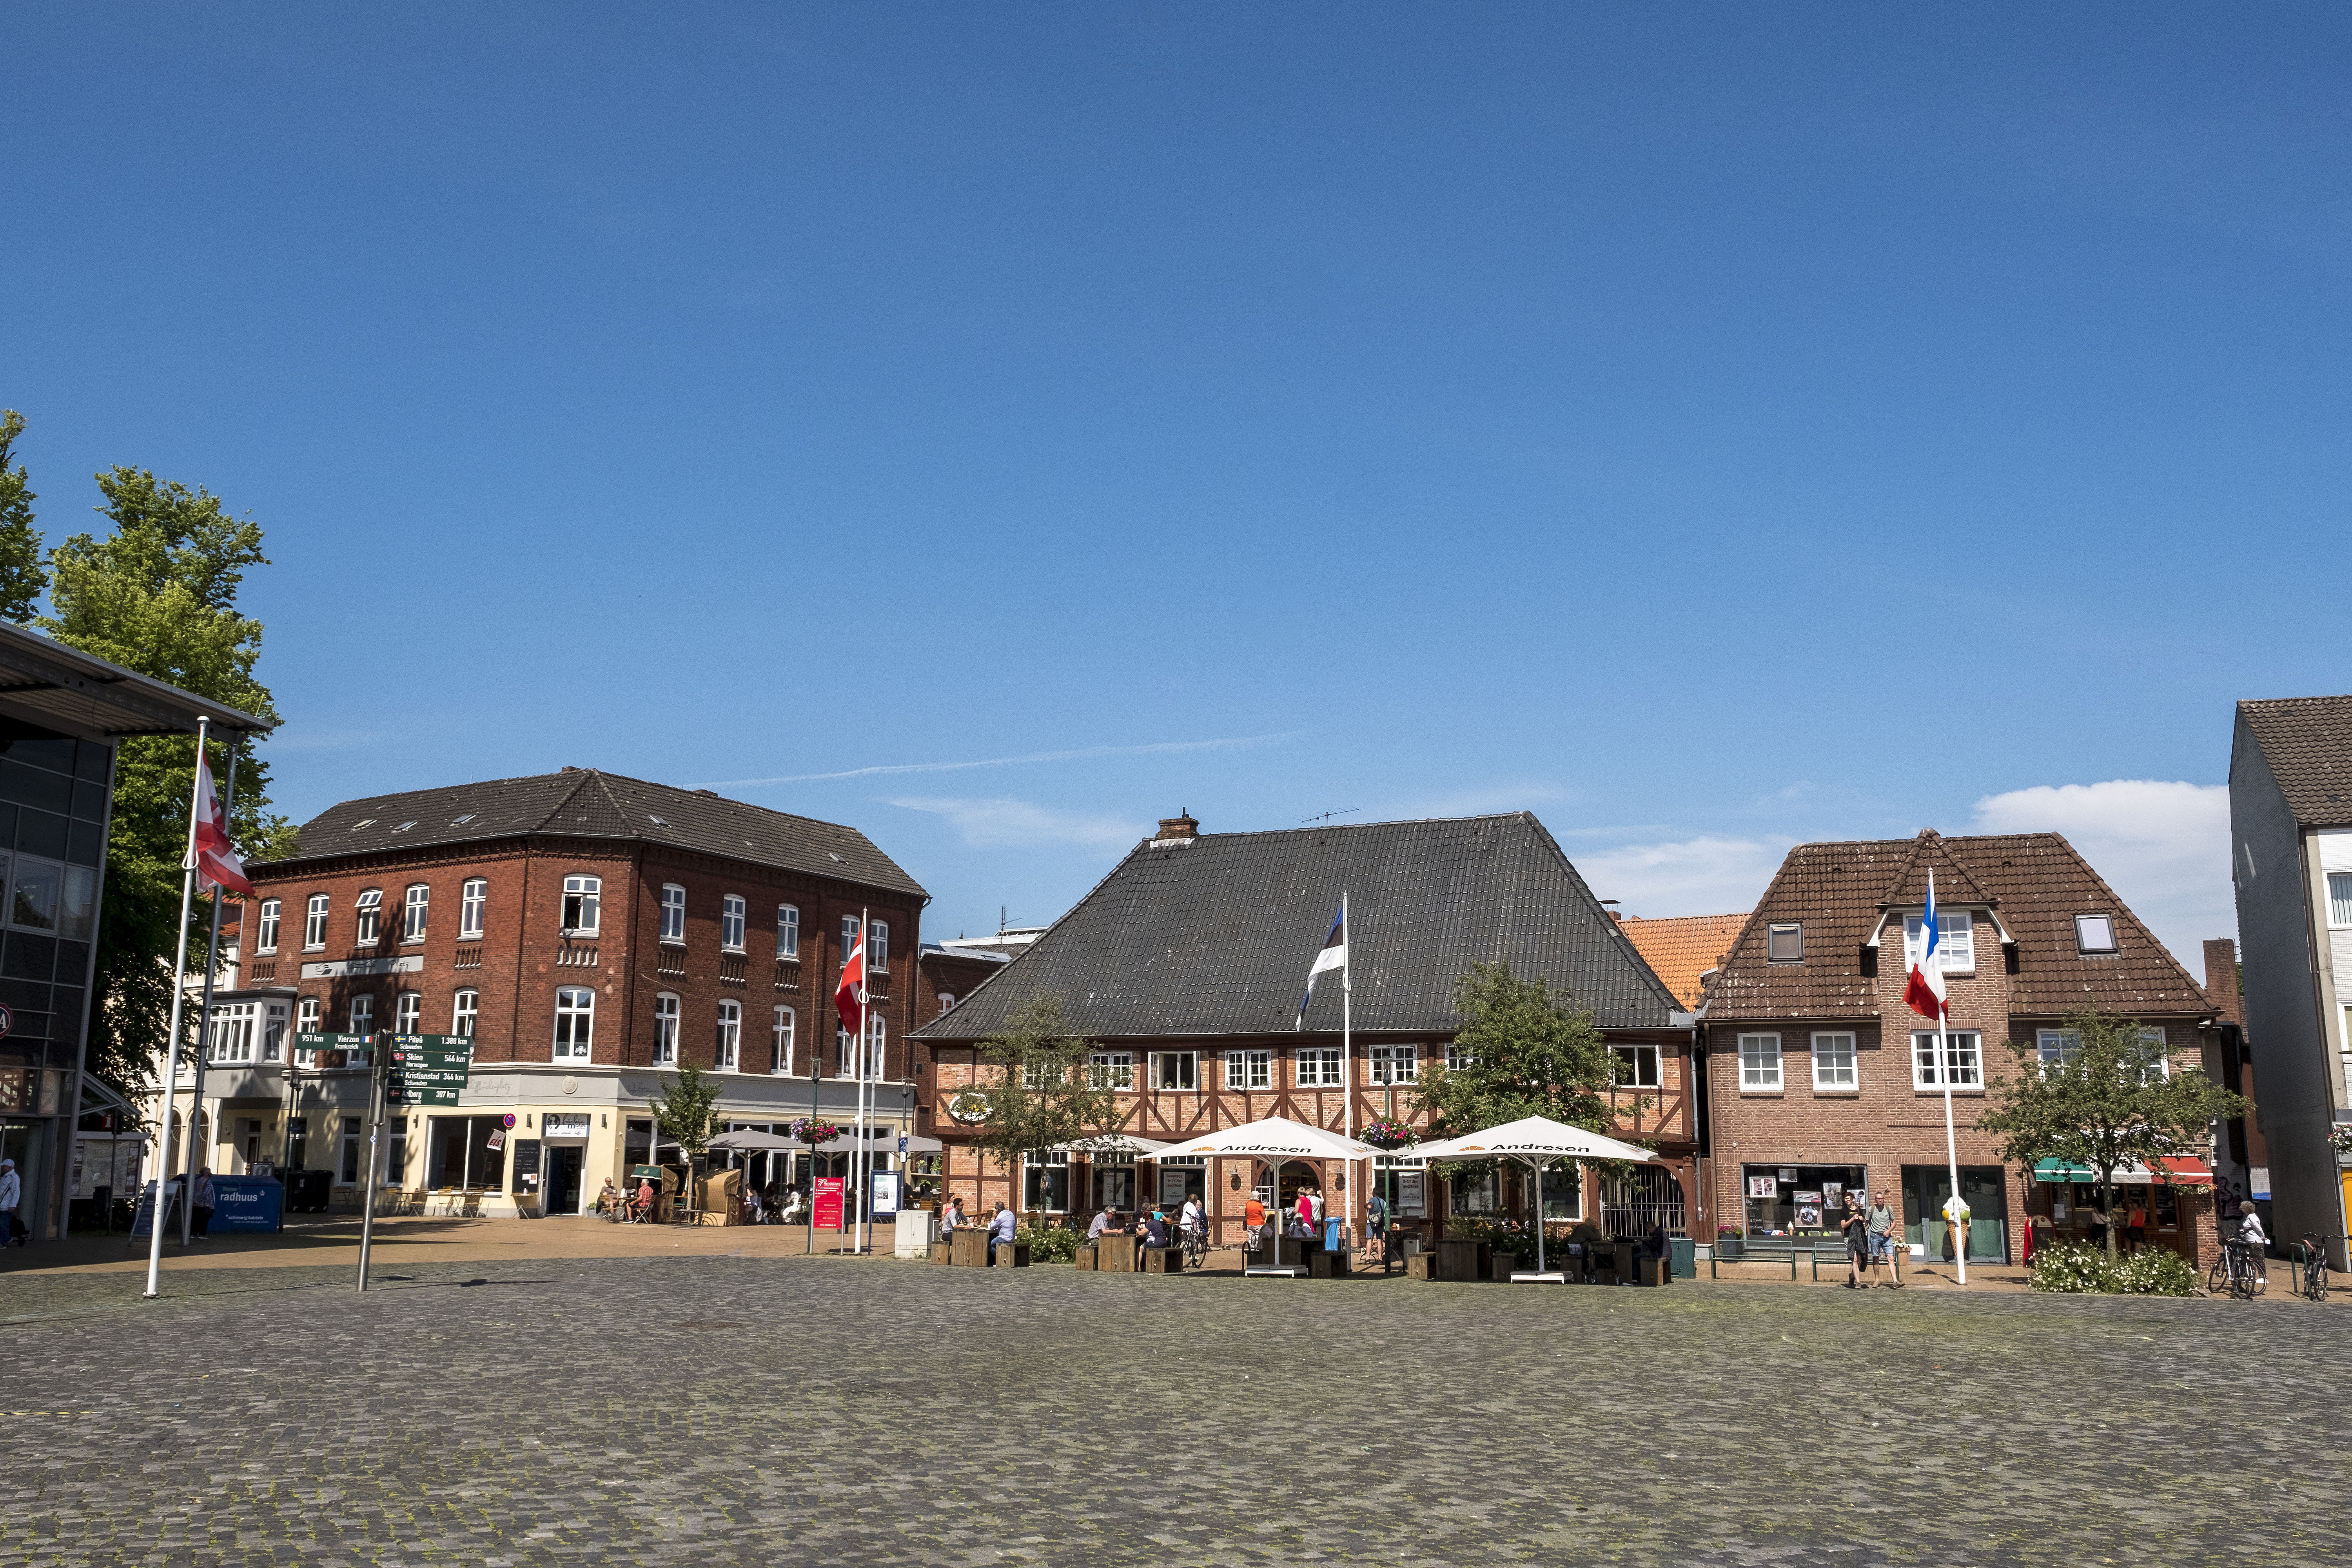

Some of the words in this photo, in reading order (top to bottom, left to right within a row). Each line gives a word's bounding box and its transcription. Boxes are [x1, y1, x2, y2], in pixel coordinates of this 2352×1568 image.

[405, 1072, 439, 1080] Kristianstad
[402, 1090, 422, 1099] Aalborg
[1220, 1145, 1311, 1153] Andresen
[1491, 1143, 1590, 1152] Andresen
[220, 1192, 258, 1201] radhuus
